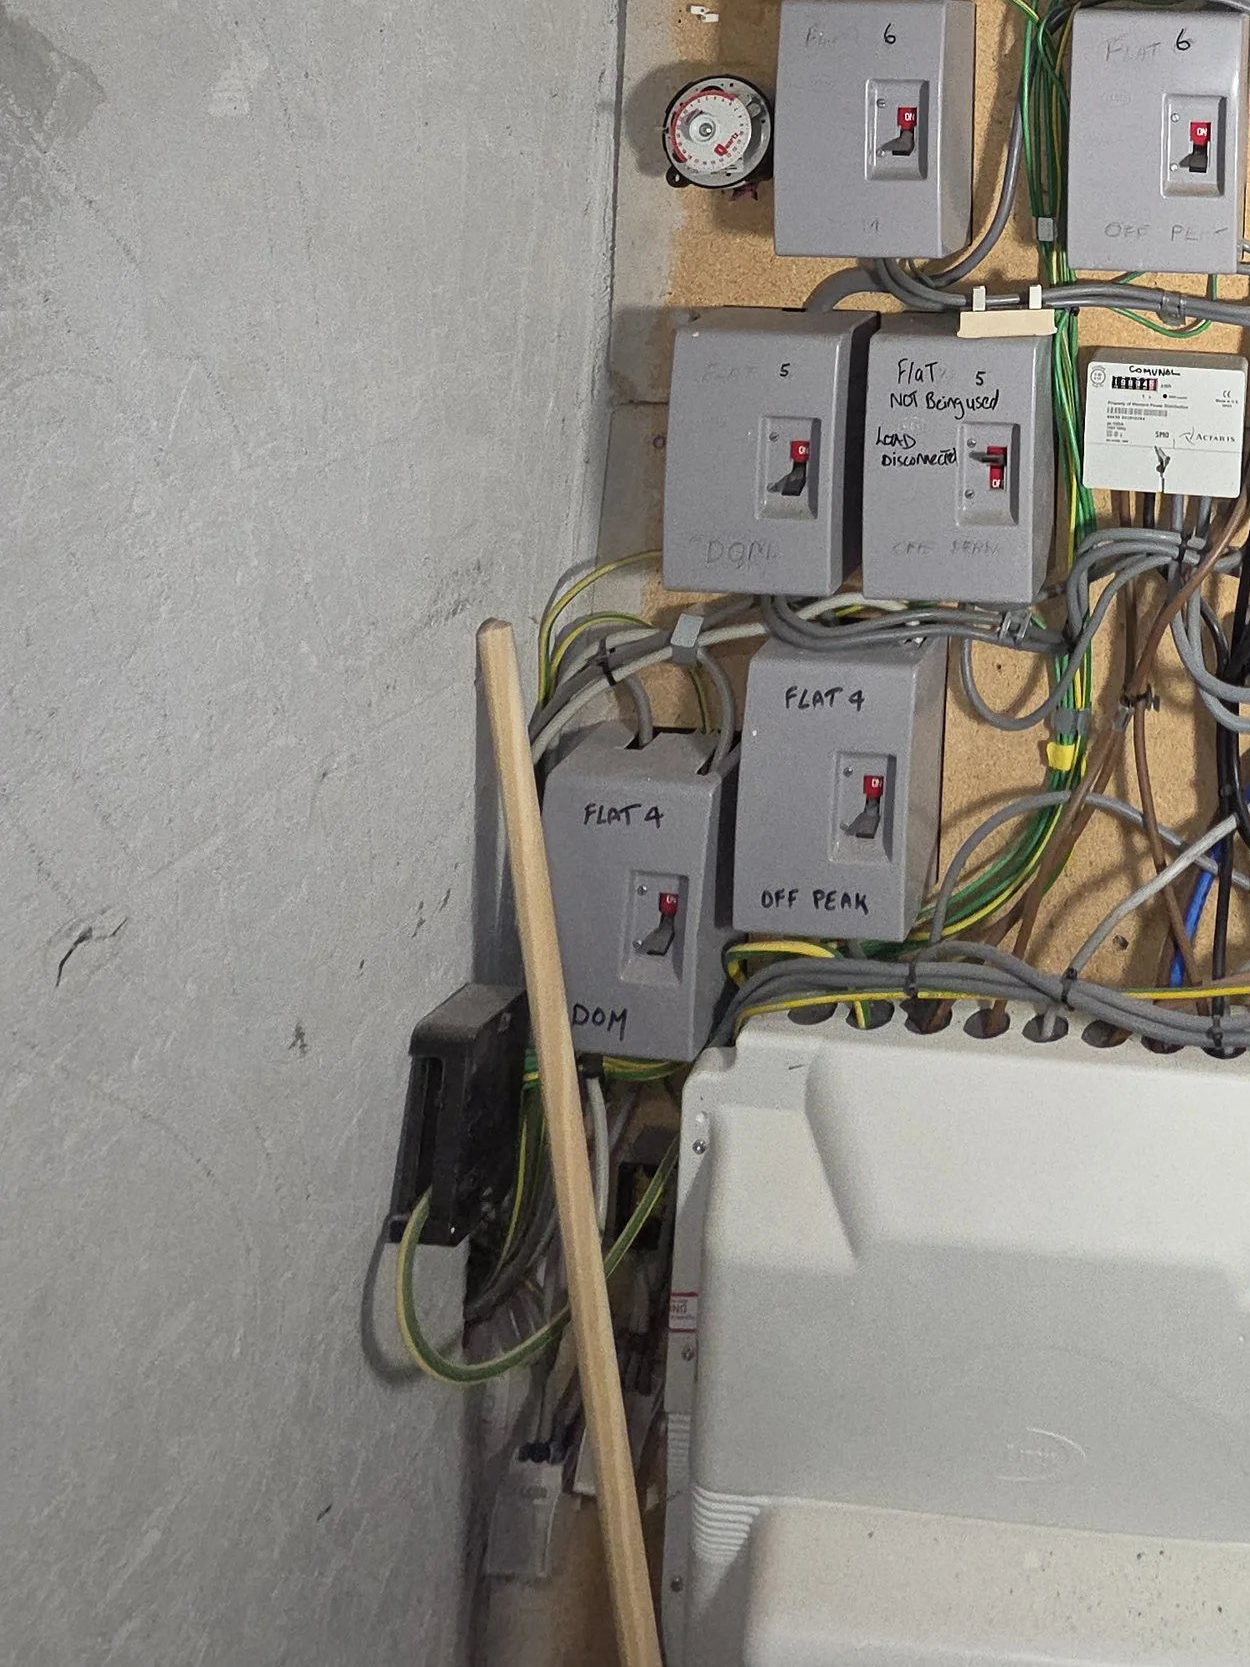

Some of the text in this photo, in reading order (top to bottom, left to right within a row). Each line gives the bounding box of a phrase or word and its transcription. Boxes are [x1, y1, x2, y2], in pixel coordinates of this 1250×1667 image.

[884, 22, 897, 45] 6
[1175, 28, 1190, 51] 6
[904, 112, 915, 121] ON
[1197, 127, 1208, 136] ON
[779, 362, 791, 377] 5
[975, 370, 986, 386] 5
[890, 390, 918, 409] NOT
[967, 387, 1000, 411] used
[875, 426, 917, 448] LOAD
[785, 685, 865, 711] FLAT 4
[583, 803, 664, 829] FLAT 4
[760, 888, 870, 916] OFF PEAK
[573, 1002, 628, 1042] DOM
